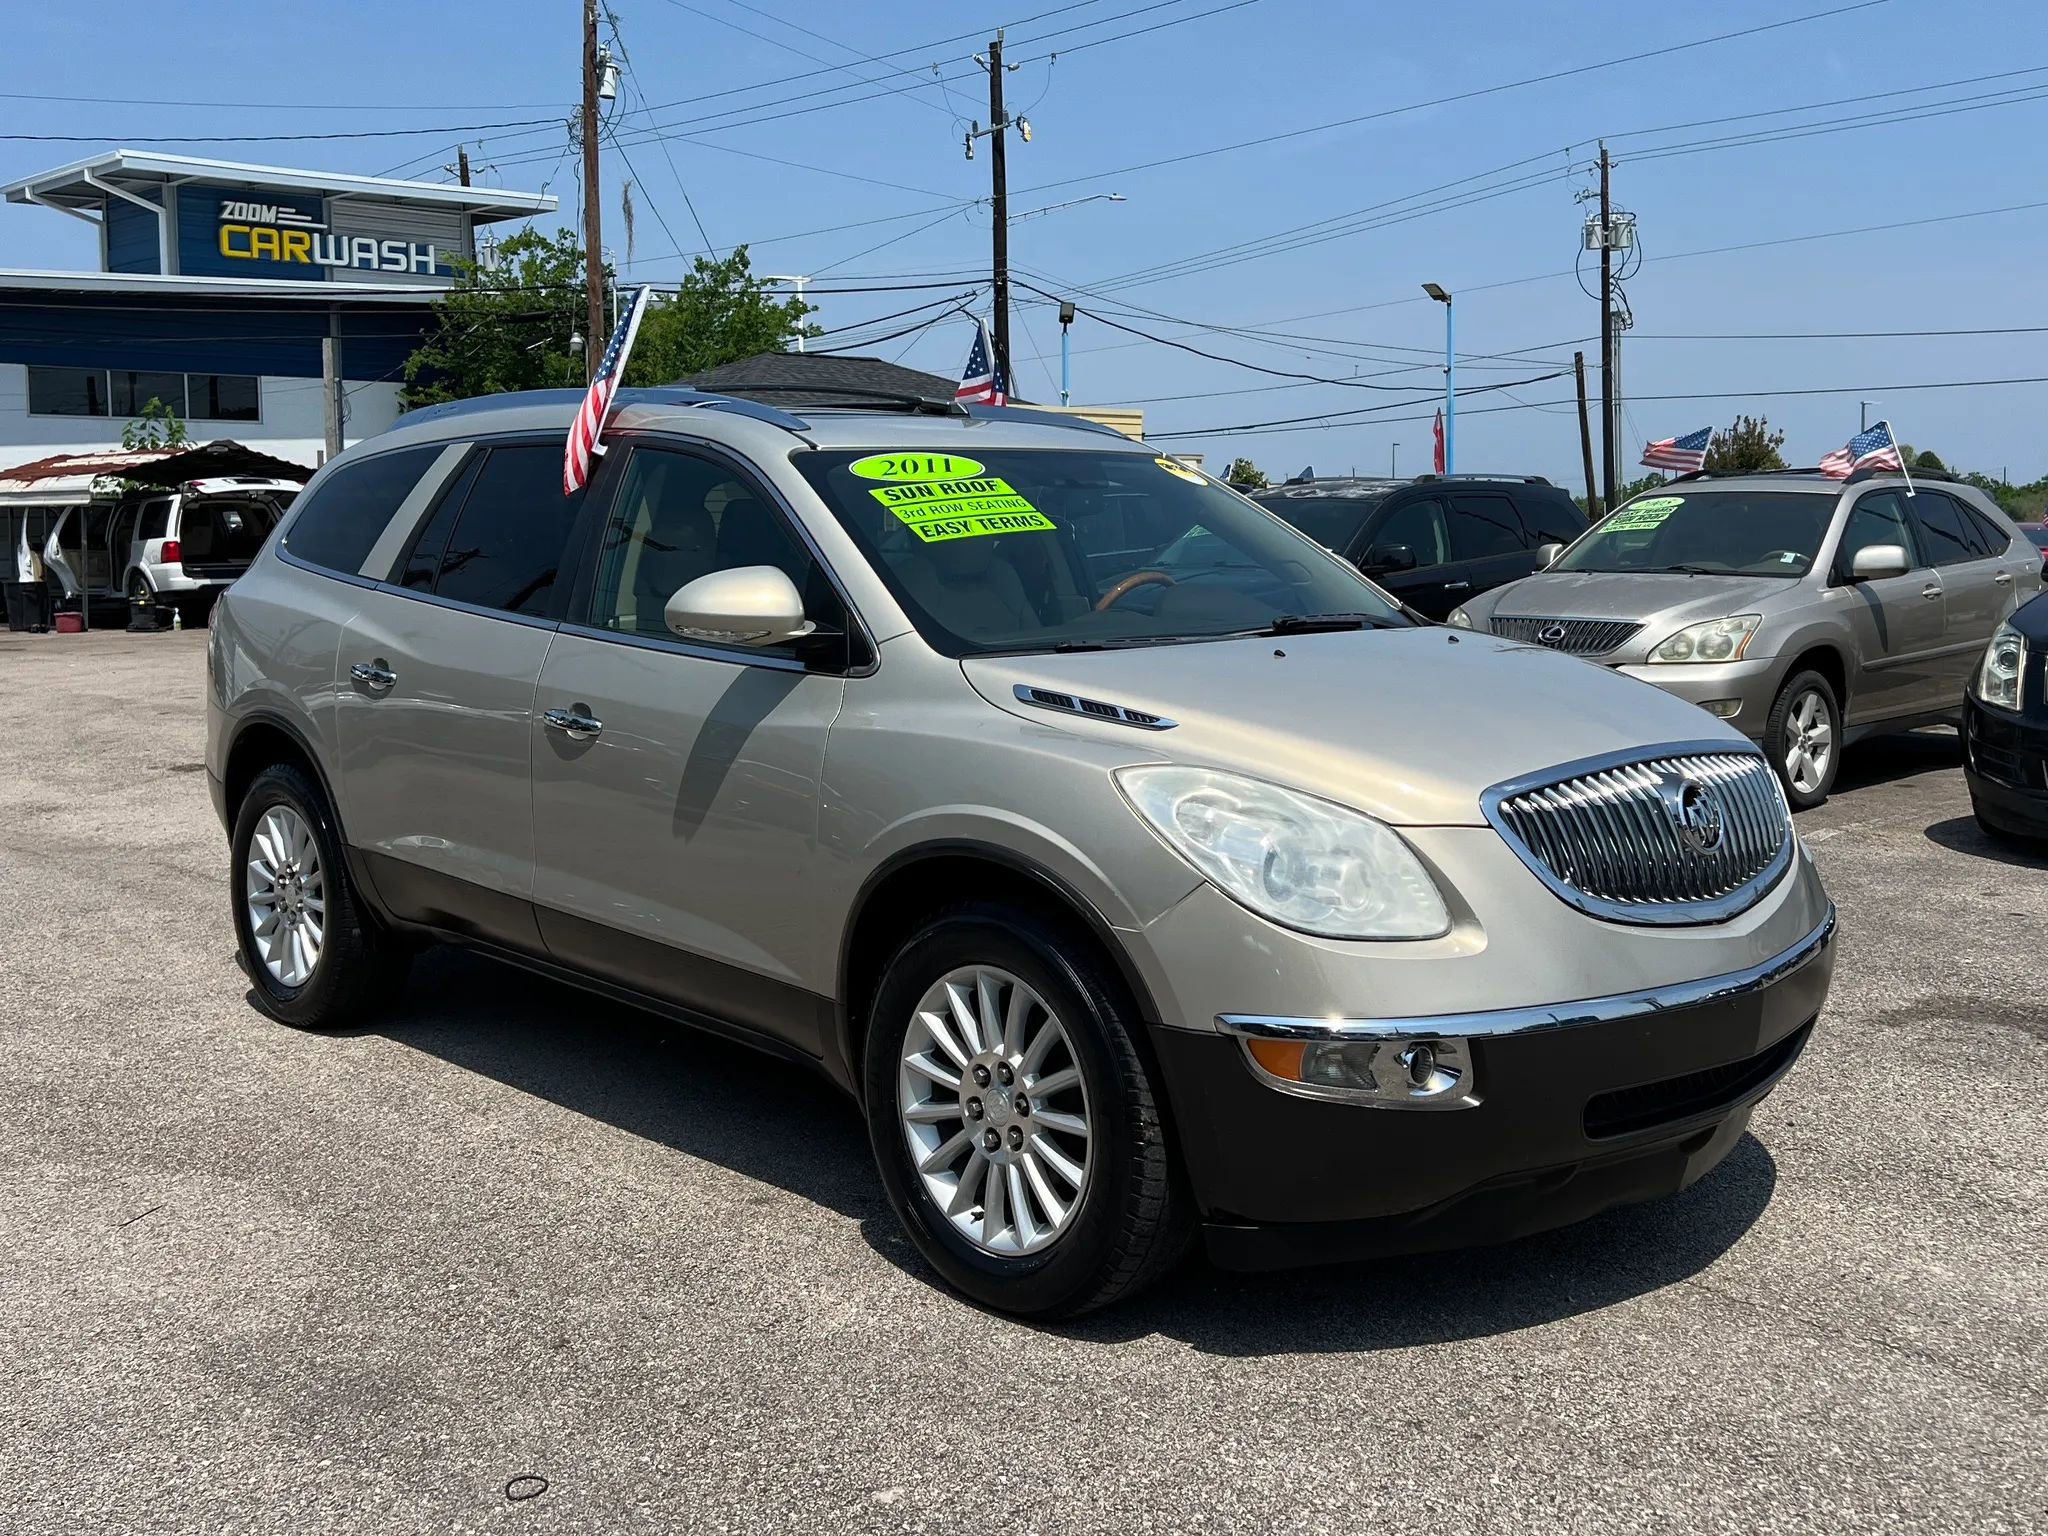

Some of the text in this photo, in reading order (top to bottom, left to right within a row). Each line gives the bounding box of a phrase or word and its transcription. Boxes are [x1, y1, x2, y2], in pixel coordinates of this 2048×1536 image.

[220, 201, 277, 223] ZOOM
[880, 458, 952, 475] 2011
[884, 480, 998, 501] SUN ROOF
[899, 498, 1026, 519] 3rd ROW SEATING
[919, 515, 1045, 538] EASY TERMS
